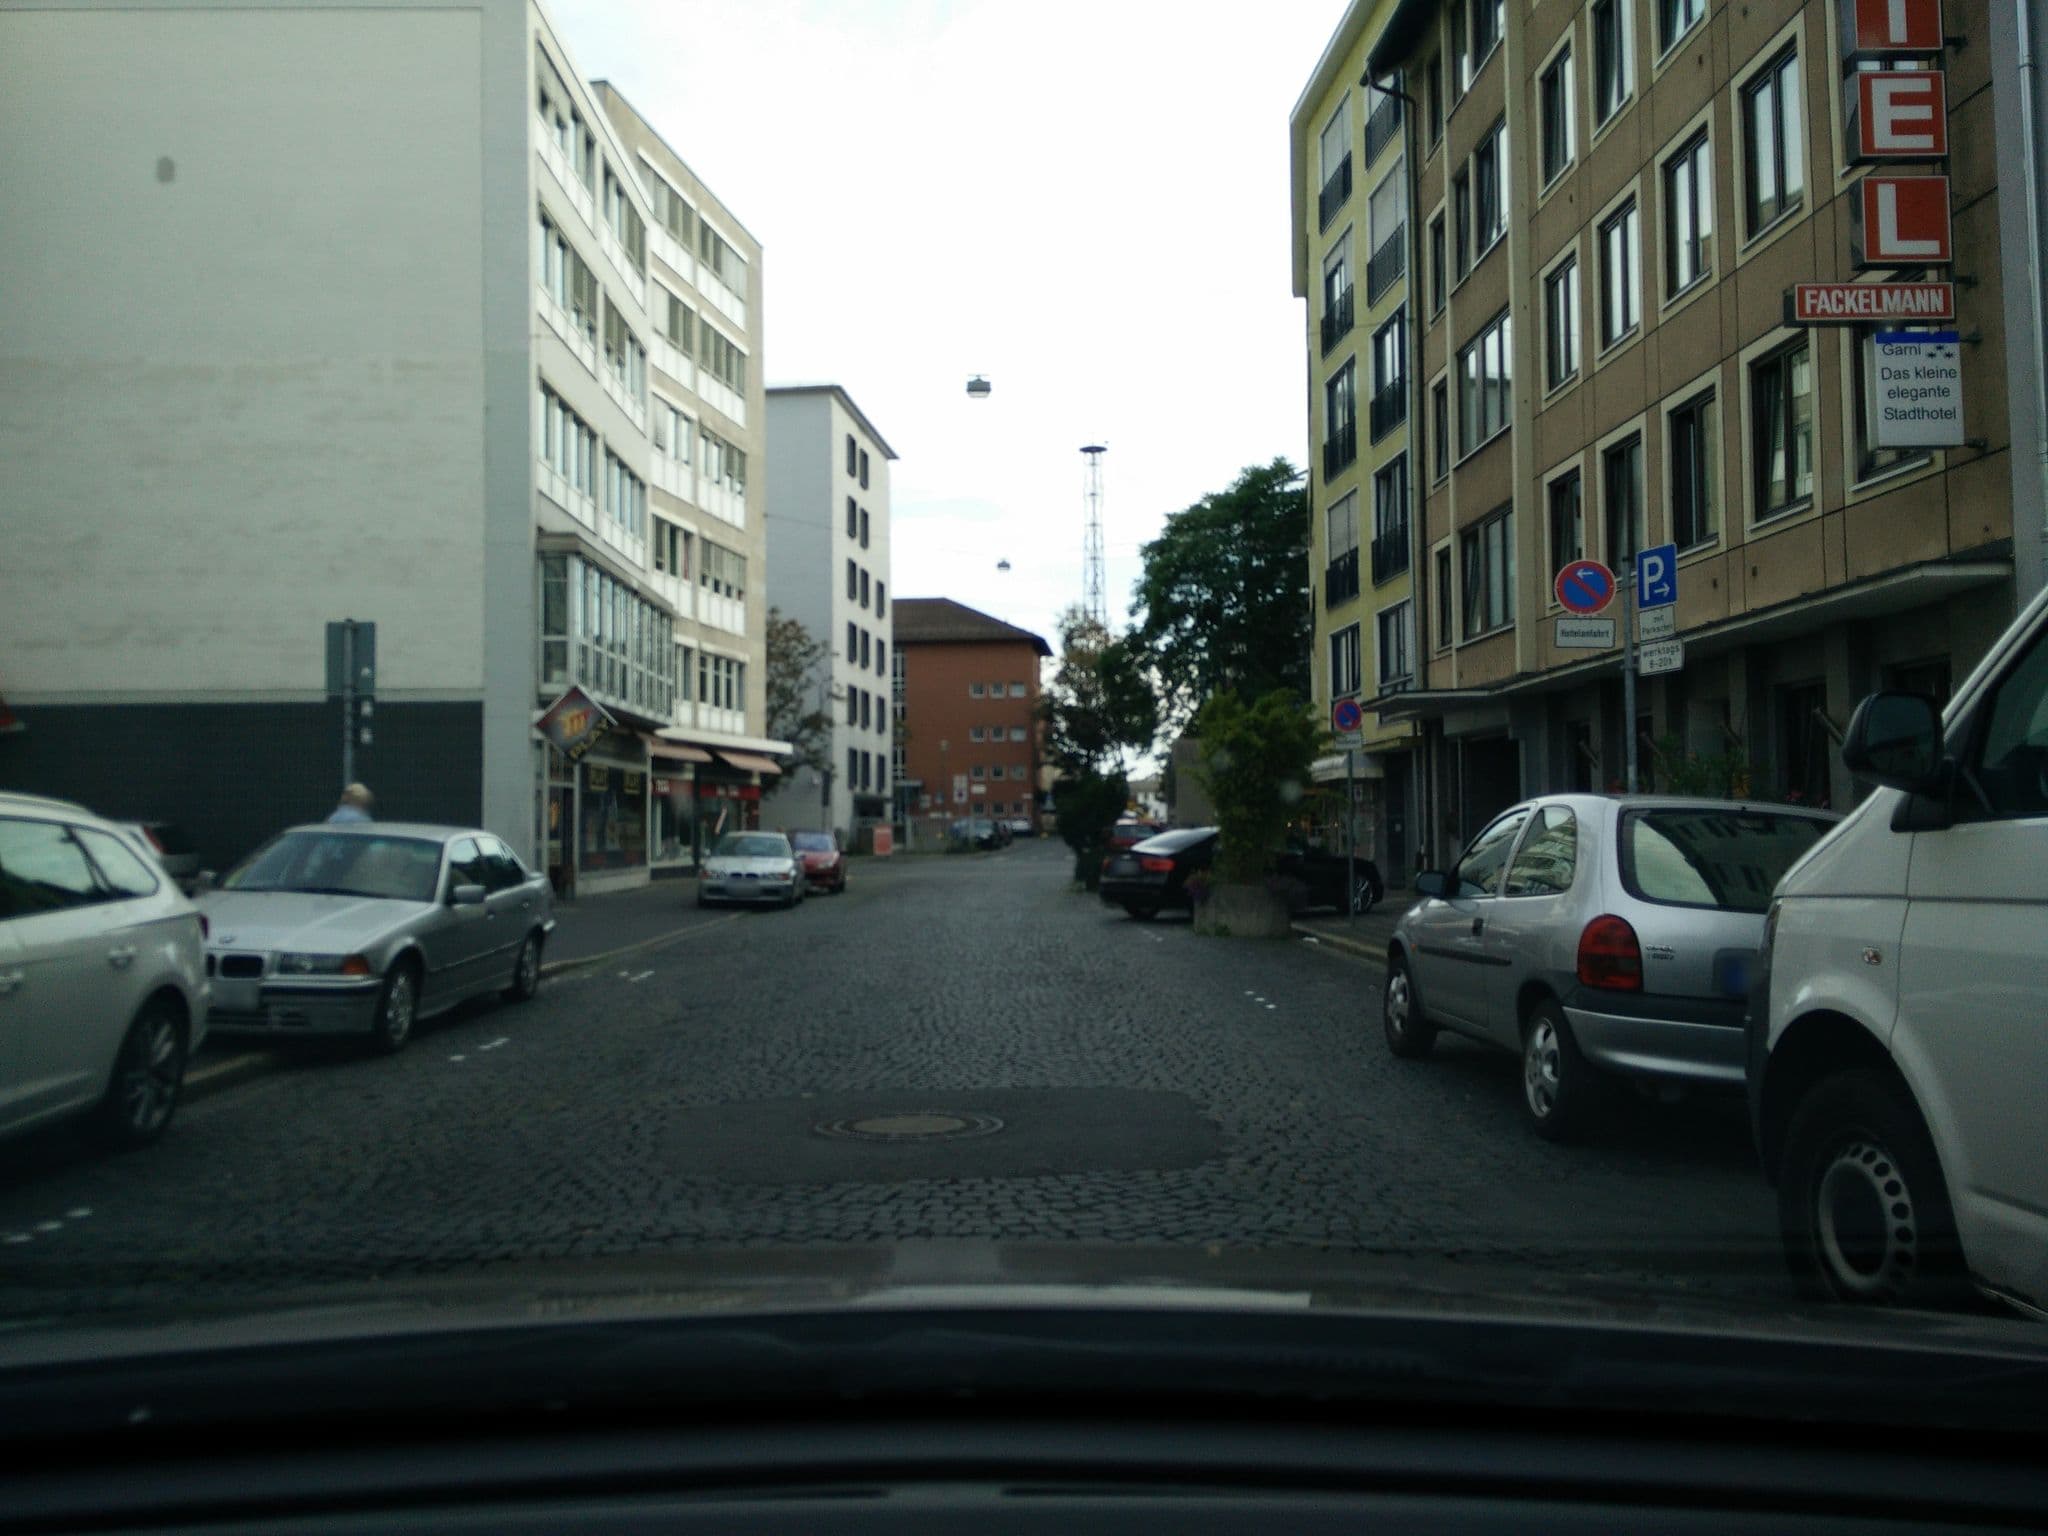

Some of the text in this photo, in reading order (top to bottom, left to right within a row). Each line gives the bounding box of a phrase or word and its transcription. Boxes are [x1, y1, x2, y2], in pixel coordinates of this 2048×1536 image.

[1804, 288, 1945, 315] FACKELMANN
[1881, 342, 1922, 357] Garni
[1880, 365, 1958, 381] Das kleine
[1887, 384, 1951, 400] elegante
[1883, 406, 1958, 421] Stadthotel
[1642, 555, 1665, 601] P
